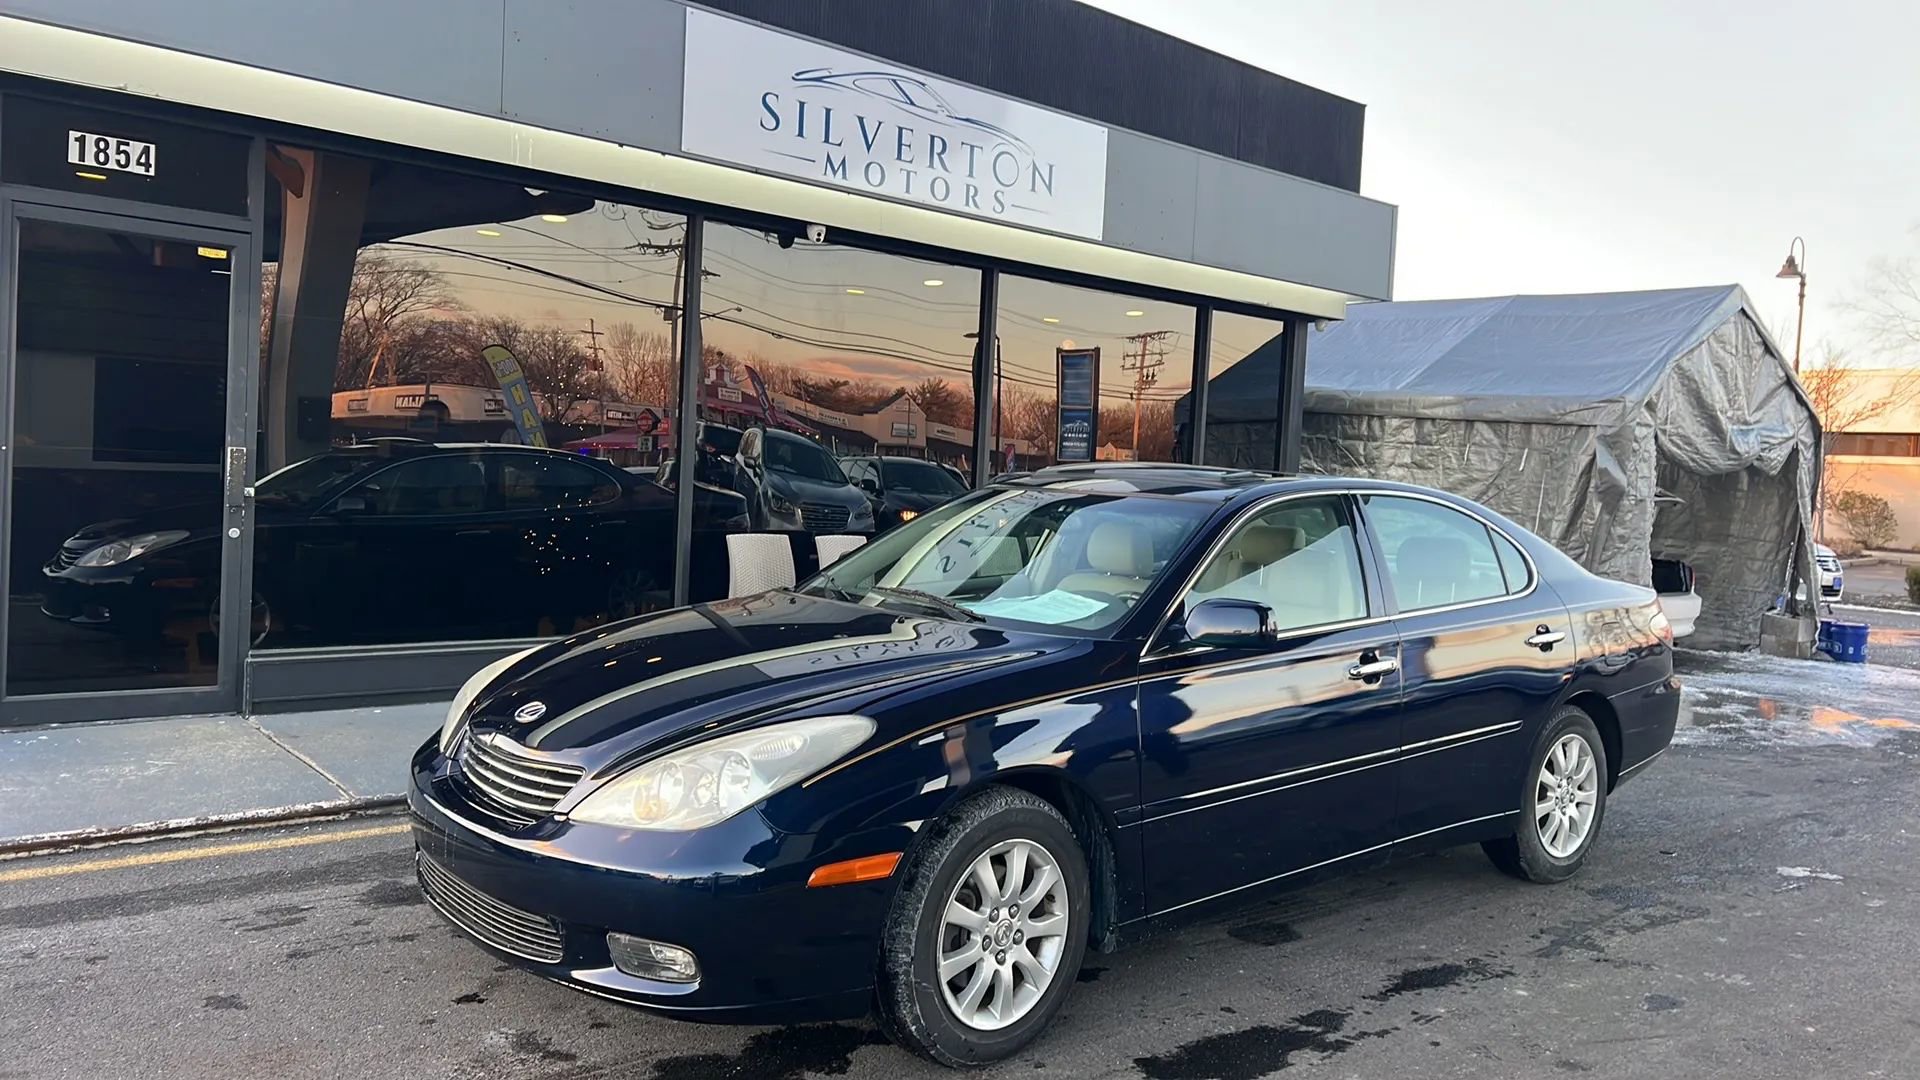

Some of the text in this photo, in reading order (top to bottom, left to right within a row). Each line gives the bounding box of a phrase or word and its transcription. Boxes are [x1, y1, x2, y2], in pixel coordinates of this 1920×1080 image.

[74, 134, 152, 173] 1854
[760, 92, 1055, 196] SILVERTON
[823, 151, 1005, 214] MOTORS
